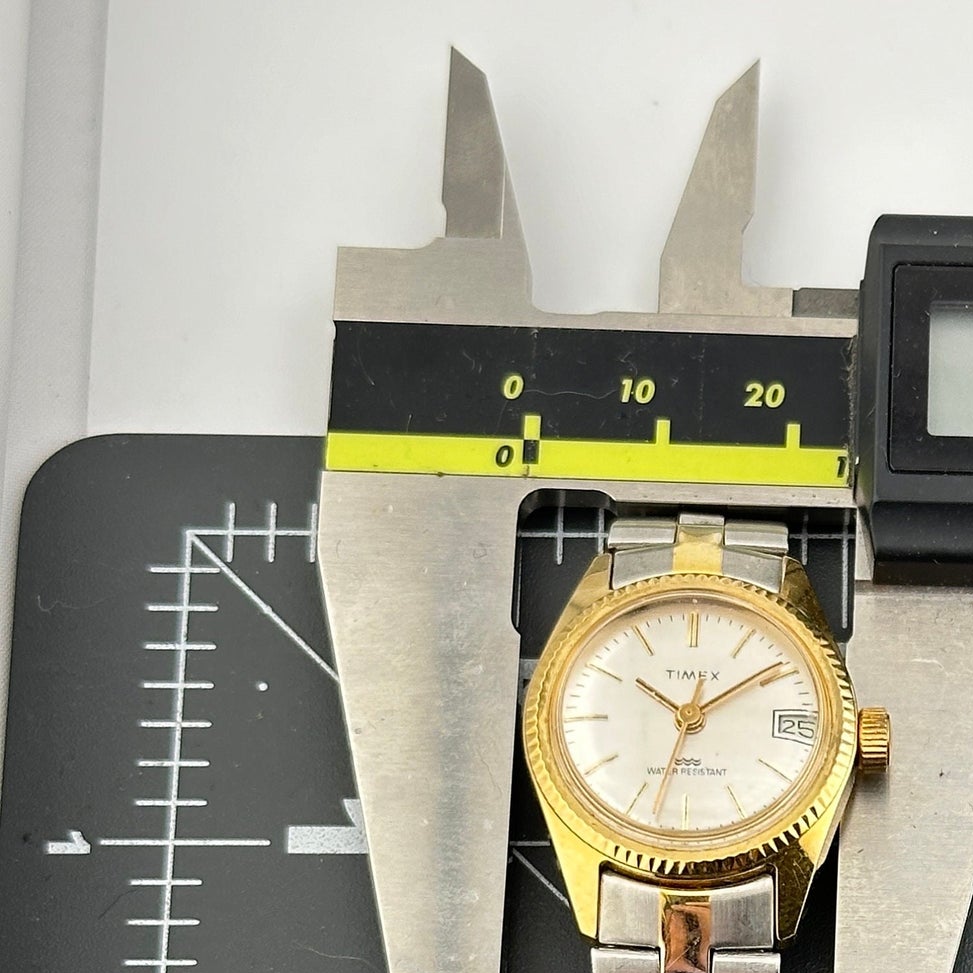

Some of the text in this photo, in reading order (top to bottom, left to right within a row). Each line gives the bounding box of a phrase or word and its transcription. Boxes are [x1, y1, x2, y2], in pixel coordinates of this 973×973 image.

[502, 375, 524, 400] 0
[620, 379, 656, 404] 10
[743, 383, 786, 409] 20
[494, 443, 513, 468] 0
[666, 669, 721, 681] TIMEX
[782, 719, 816, 739] 25
[647, 767, 727, 777] WATR RESISTANT
[46, 831, 91, 855] 1
